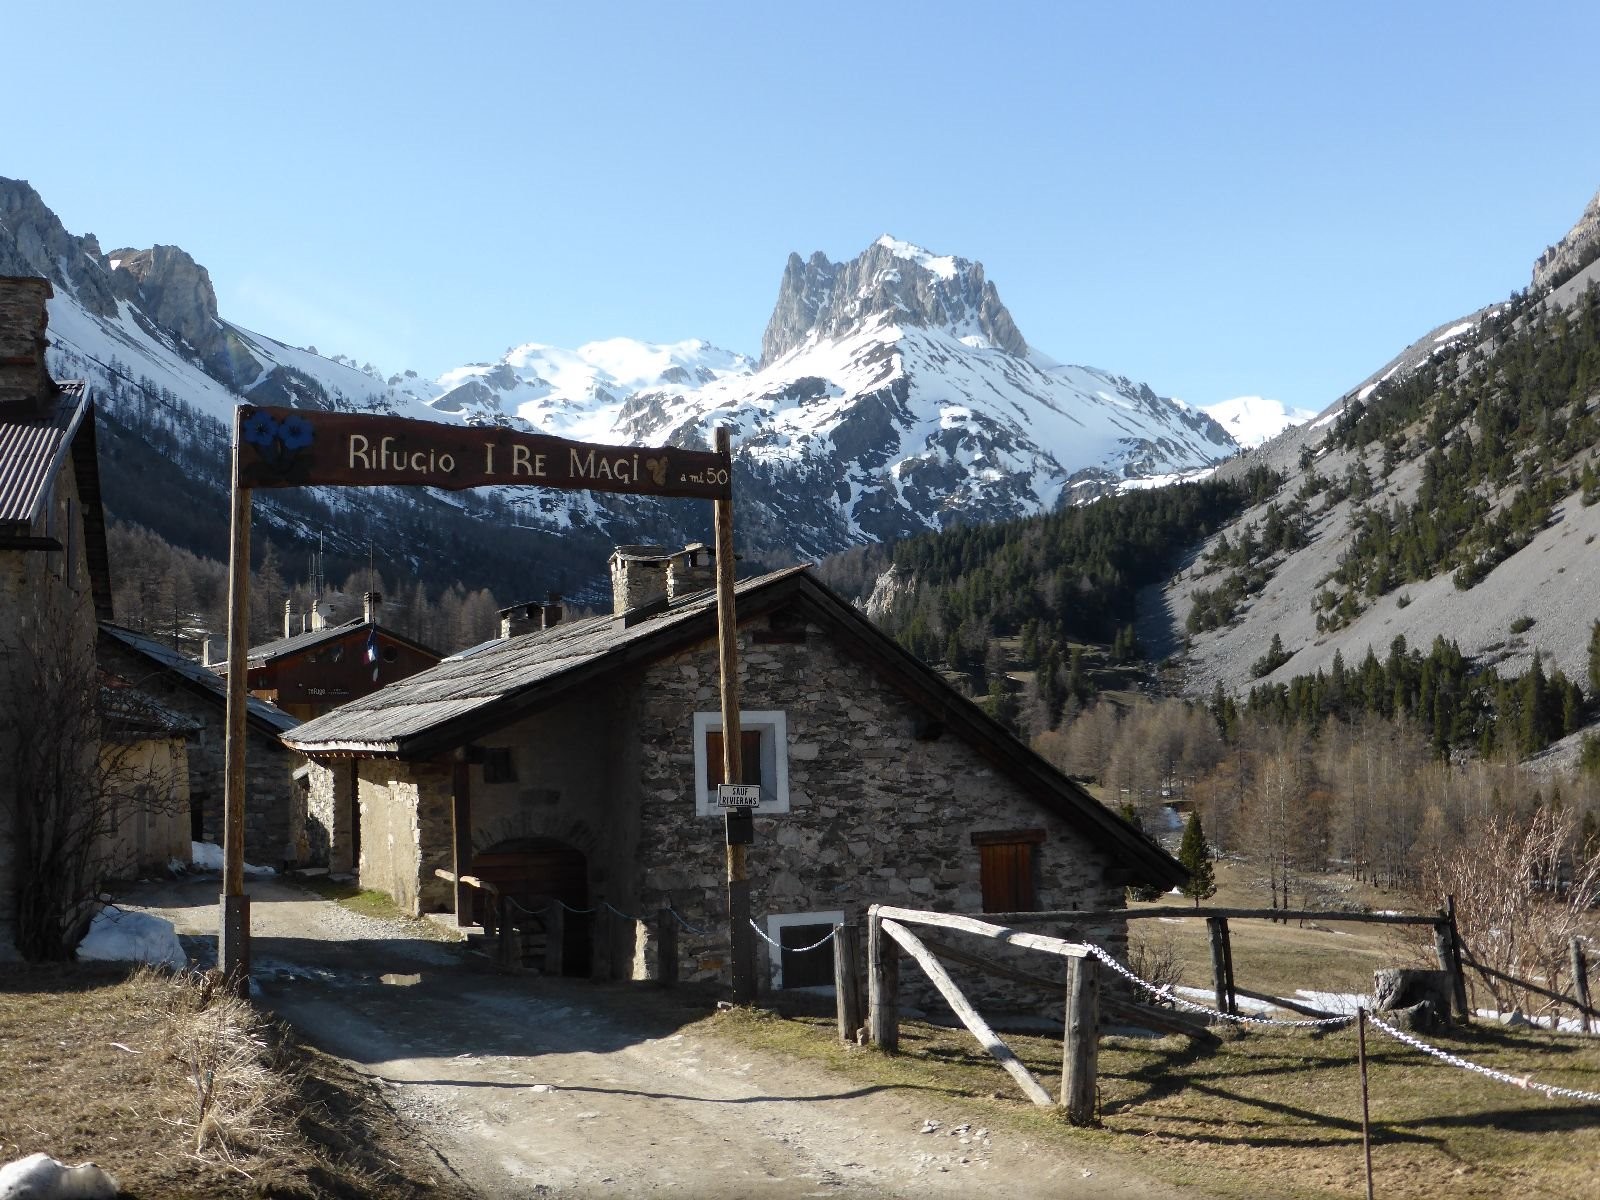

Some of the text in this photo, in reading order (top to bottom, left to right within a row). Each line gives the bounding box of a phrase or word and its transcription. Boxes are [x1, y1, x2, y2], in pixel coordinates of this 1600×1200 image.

[349, 434, 456, 475] Rifugio
[484, 442, 497, 475] I
[706, 467, 729, 485] 50
[732, 787, 749, 796] SAUF
